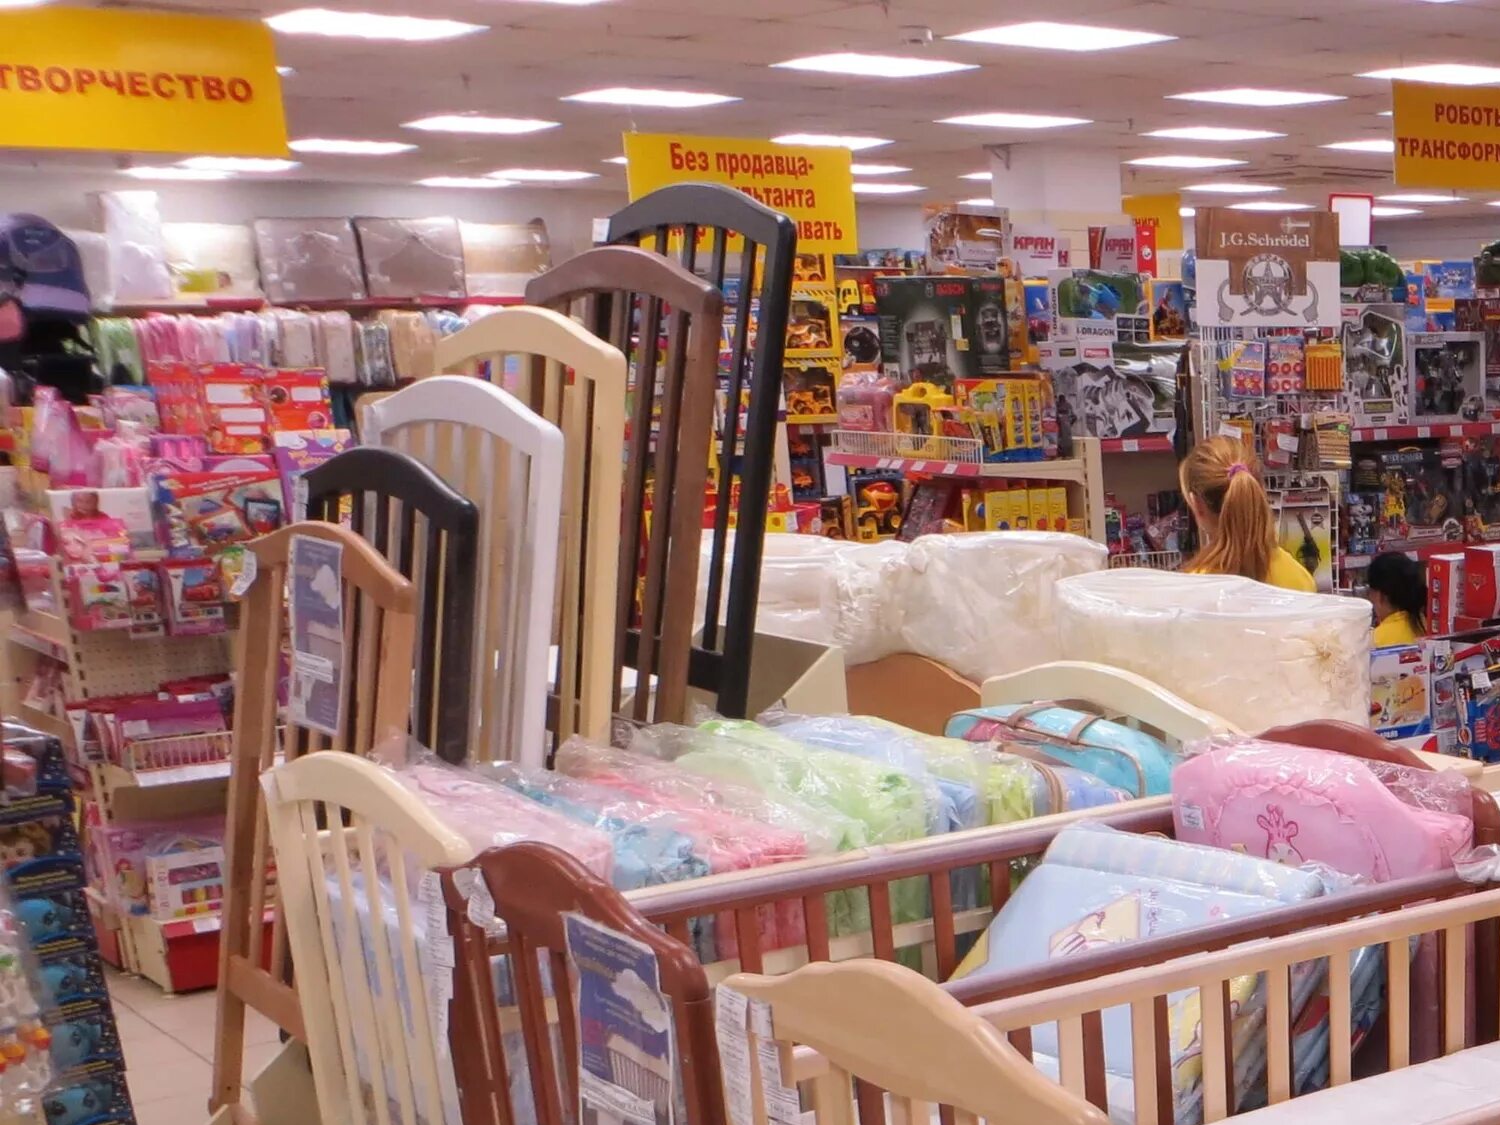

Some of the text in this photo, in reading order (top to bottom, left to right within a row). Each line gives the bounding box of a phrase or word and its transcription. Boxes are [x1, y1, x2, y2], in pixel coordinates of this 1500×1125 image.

[669, 142, 814, 180] Без продавца-
[1013, 235, 1056, 251] КРАН
[1104, 238, 1135, 252] КРАН
[1219, 231, 1311, 249] J.G.Schrödel
[1076, 326, 1116, 337] I-DRAGON
